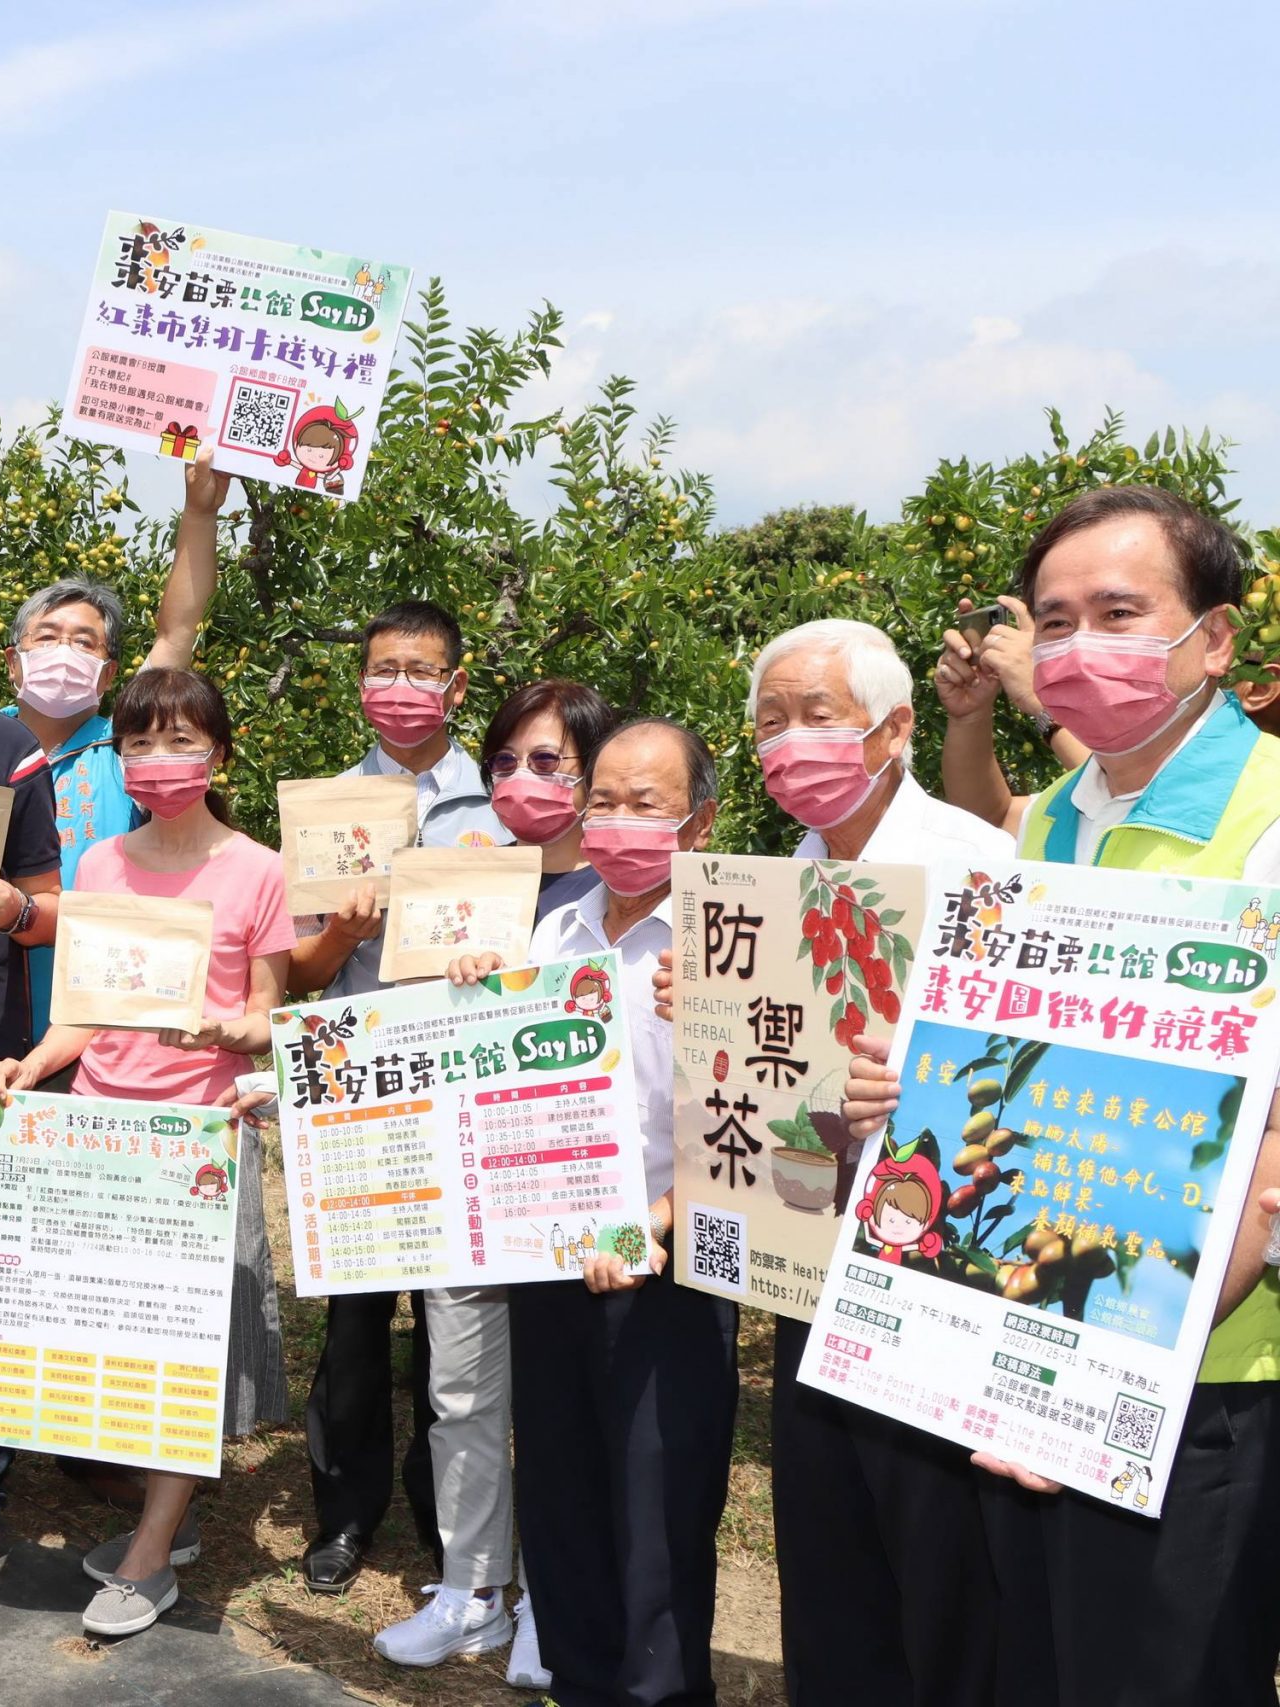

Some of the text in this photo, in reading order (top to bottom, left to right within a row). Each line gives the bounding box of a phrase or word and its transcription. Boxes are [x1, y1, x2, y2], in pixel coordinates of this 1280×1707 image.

[97, 300, 377, 385] 紅棗市集打卡送好禮
[682, 889, 697, 982] 苗栗公館
[682, 995, 742, 1018] HEALTHY
[920, 966, 1258, 1062] 棗安圖徵件競賽
[683, 1022, 735, 1044] HERBAL
[682, 1047, 708, 1065] TEA
[1029, 1079, 1209, 1138] 有空來苗栗公館
[750, 1248, 787, 1273] 防禦茶
[880, 1331, 902, 1348] 公告
